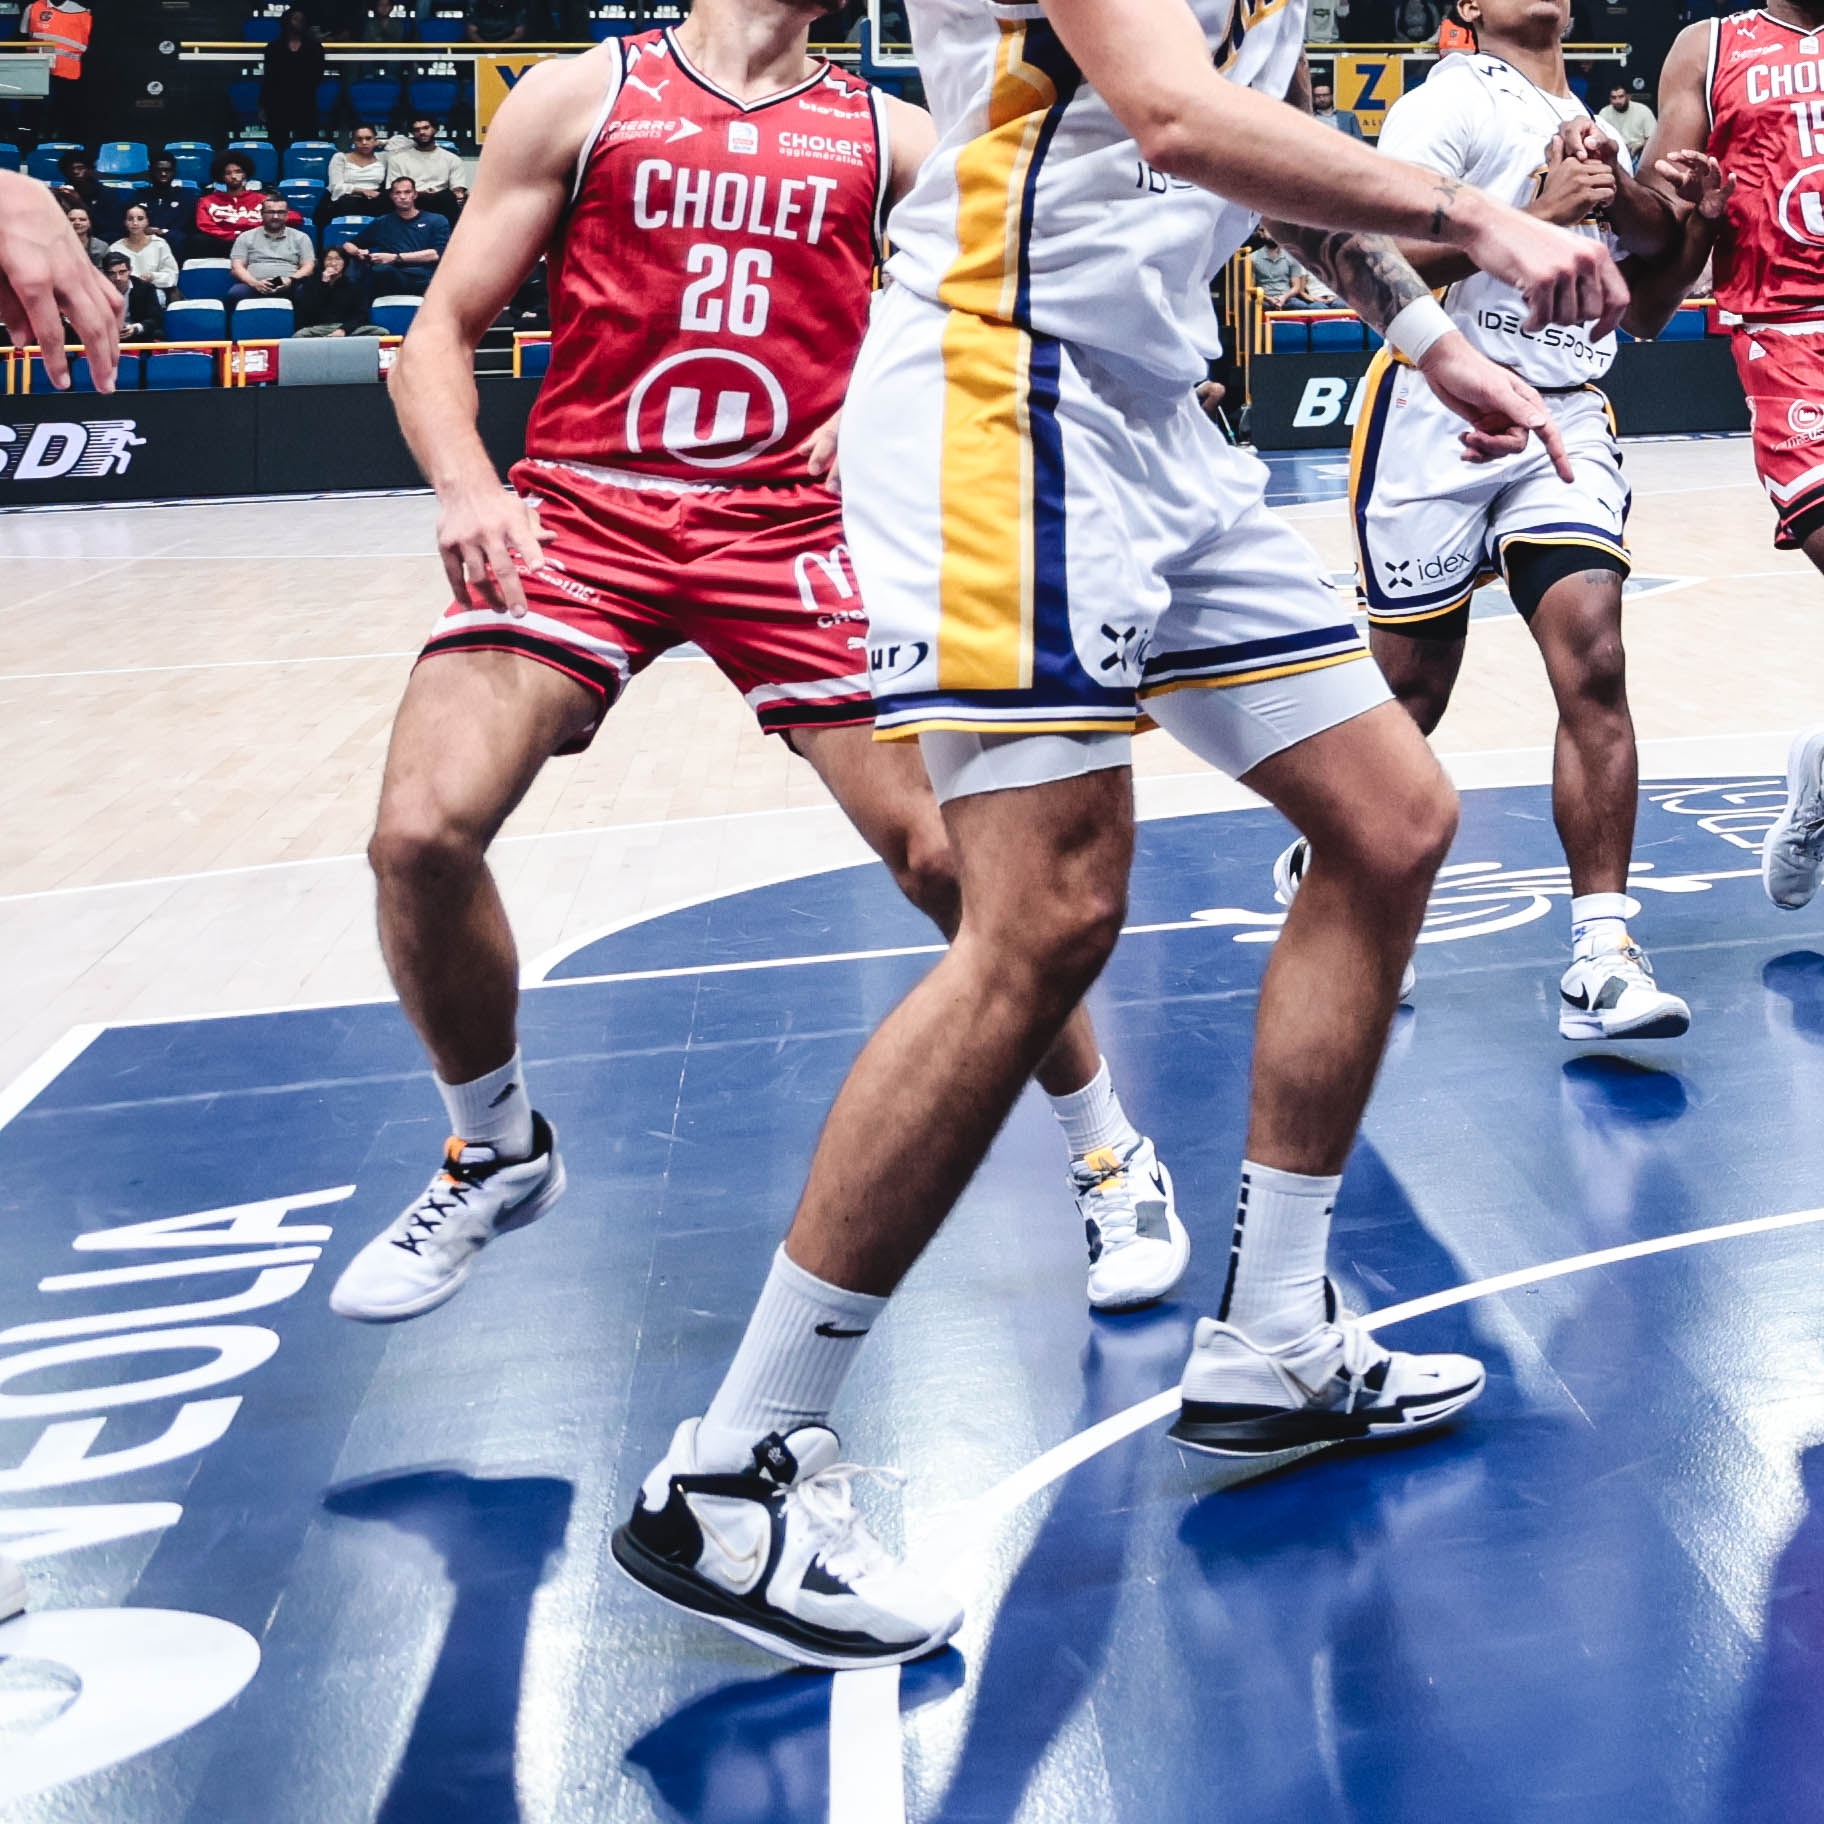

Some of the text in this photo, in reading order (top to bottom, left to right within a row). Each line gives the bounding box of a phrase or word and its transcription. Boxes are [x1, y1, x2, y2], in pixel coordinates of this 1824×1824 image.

[1354, 64, 1387, 110] Z
[608, 119, 676, 133] PIERRE
[779, 147, 864, 167] agglomération
[633, 159, 838, 245] CHOLET
[680, 243, 773, 337] 26
[1416, 550, 1471, 583] idex
